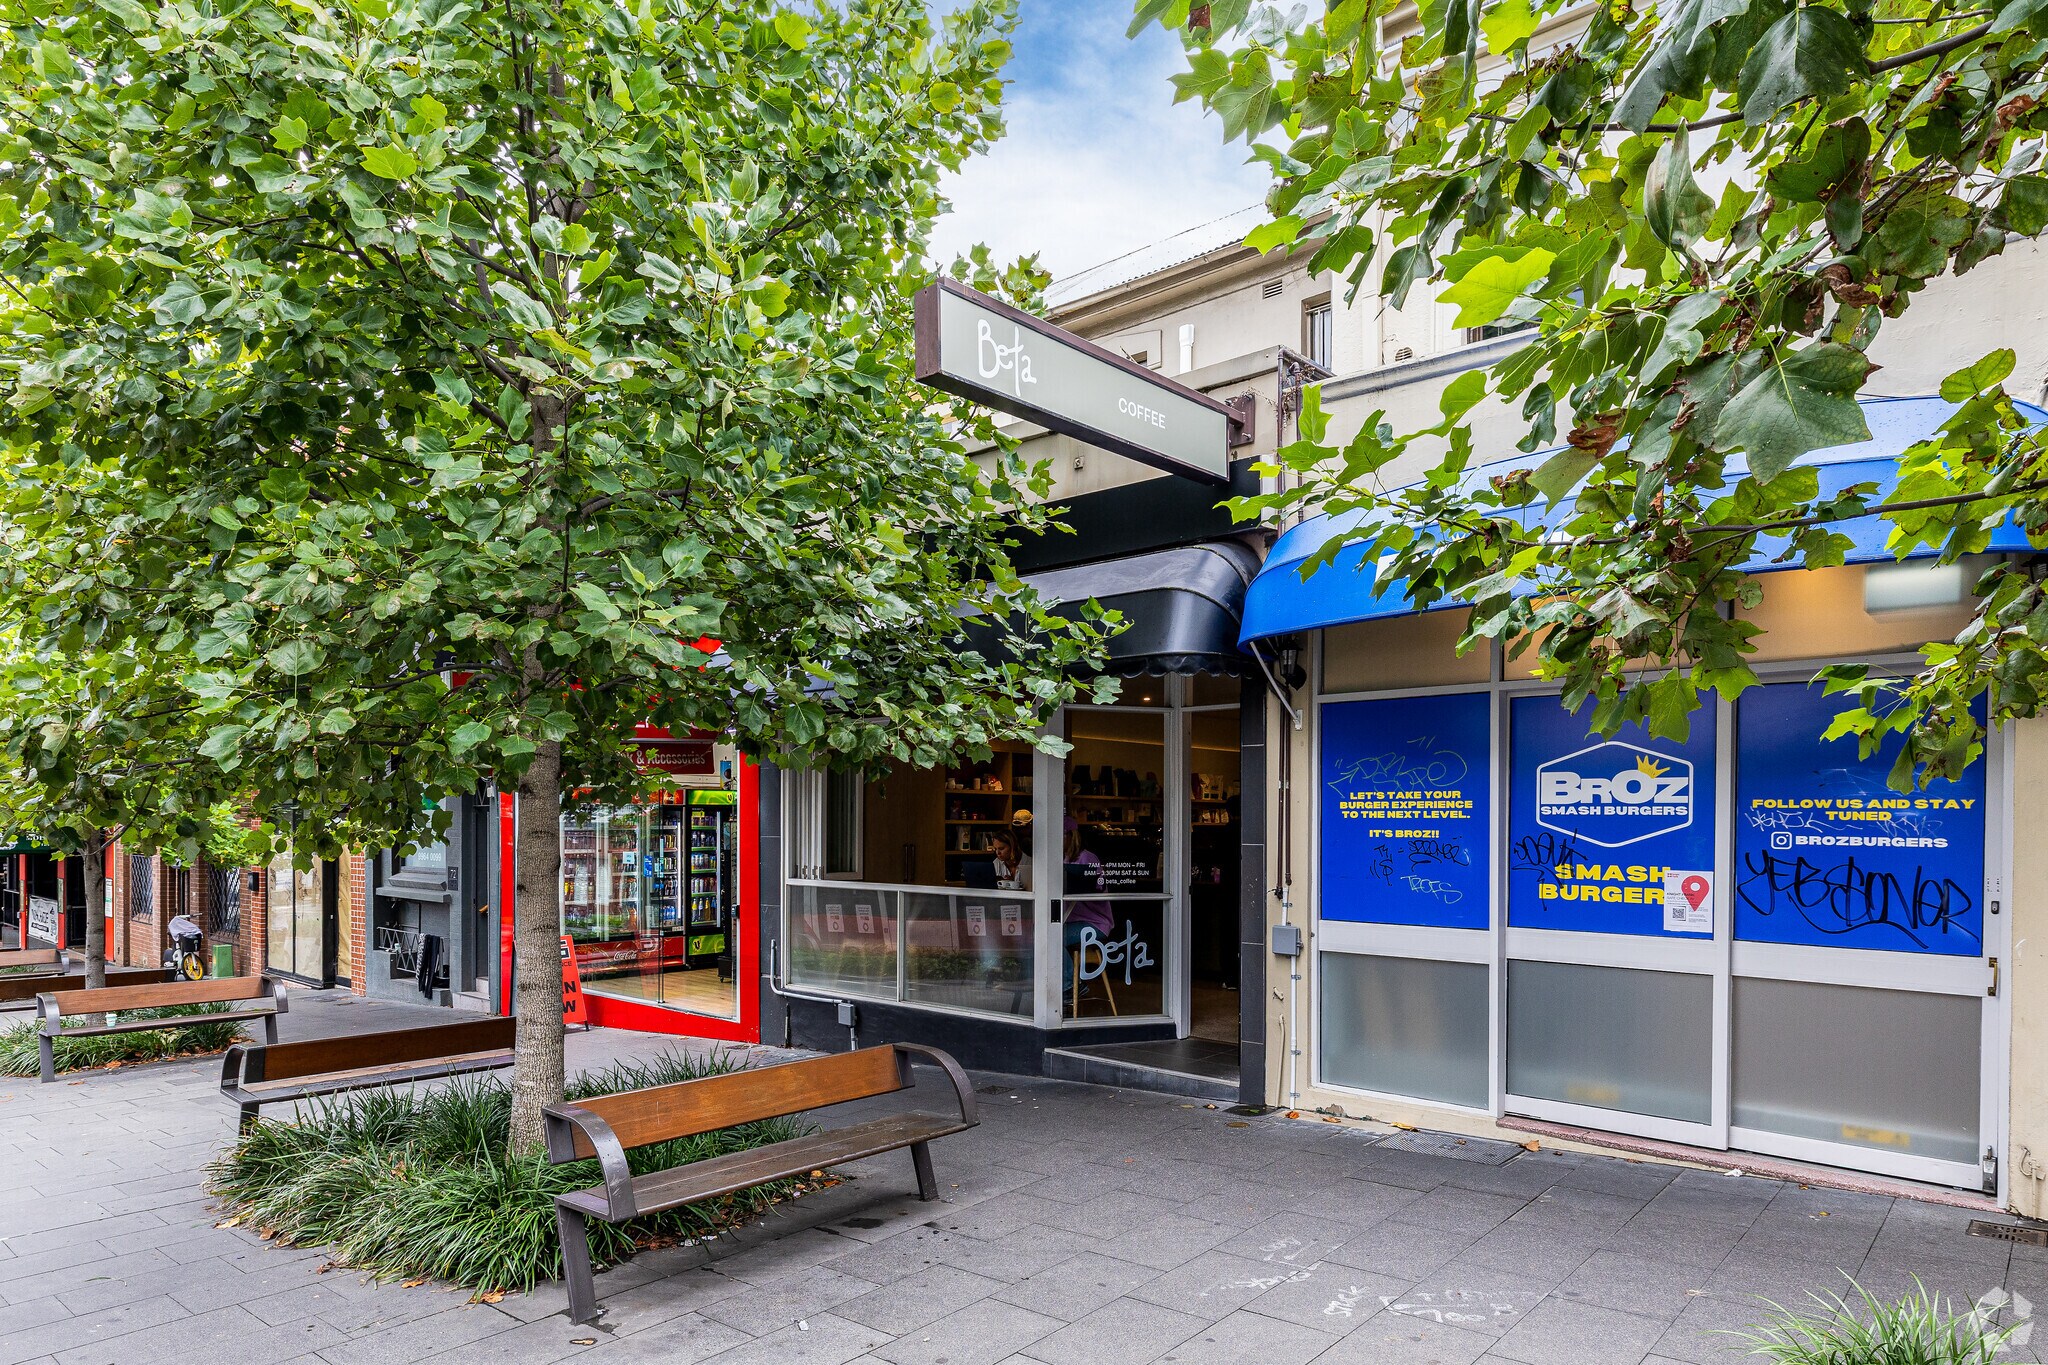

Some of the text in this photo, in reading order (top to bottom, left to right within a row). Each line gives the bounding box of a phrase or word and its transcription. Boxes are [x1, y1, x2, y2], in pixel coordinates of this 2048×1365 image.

[978, 319, 1037, 397] Beta
[1119, 397, 1166, 430] COFFEE
[1349, 790, 1461, 800] LET'S TAKE YOUR
[1339, 800, 1473, 809] BURGER EXPERIENCE
[1752, 799, 1976, 810] FOLLOW US AND STAY
[1423, 810, 1471, 819] LEVEL.
[1541, 806, 1688, 816] SMASH BURGERS
[1825, 811, 1892, 821] TUNED
[1369, 829, 1440, 839] IT'S BROZ!!
[1795, 836, 1949, 848] BROZBURGERS
[450, 869, 457, 879] 72
[1554, 863, 1671, 882] SMASH
[1079, 919, 1155, 986] Beta
